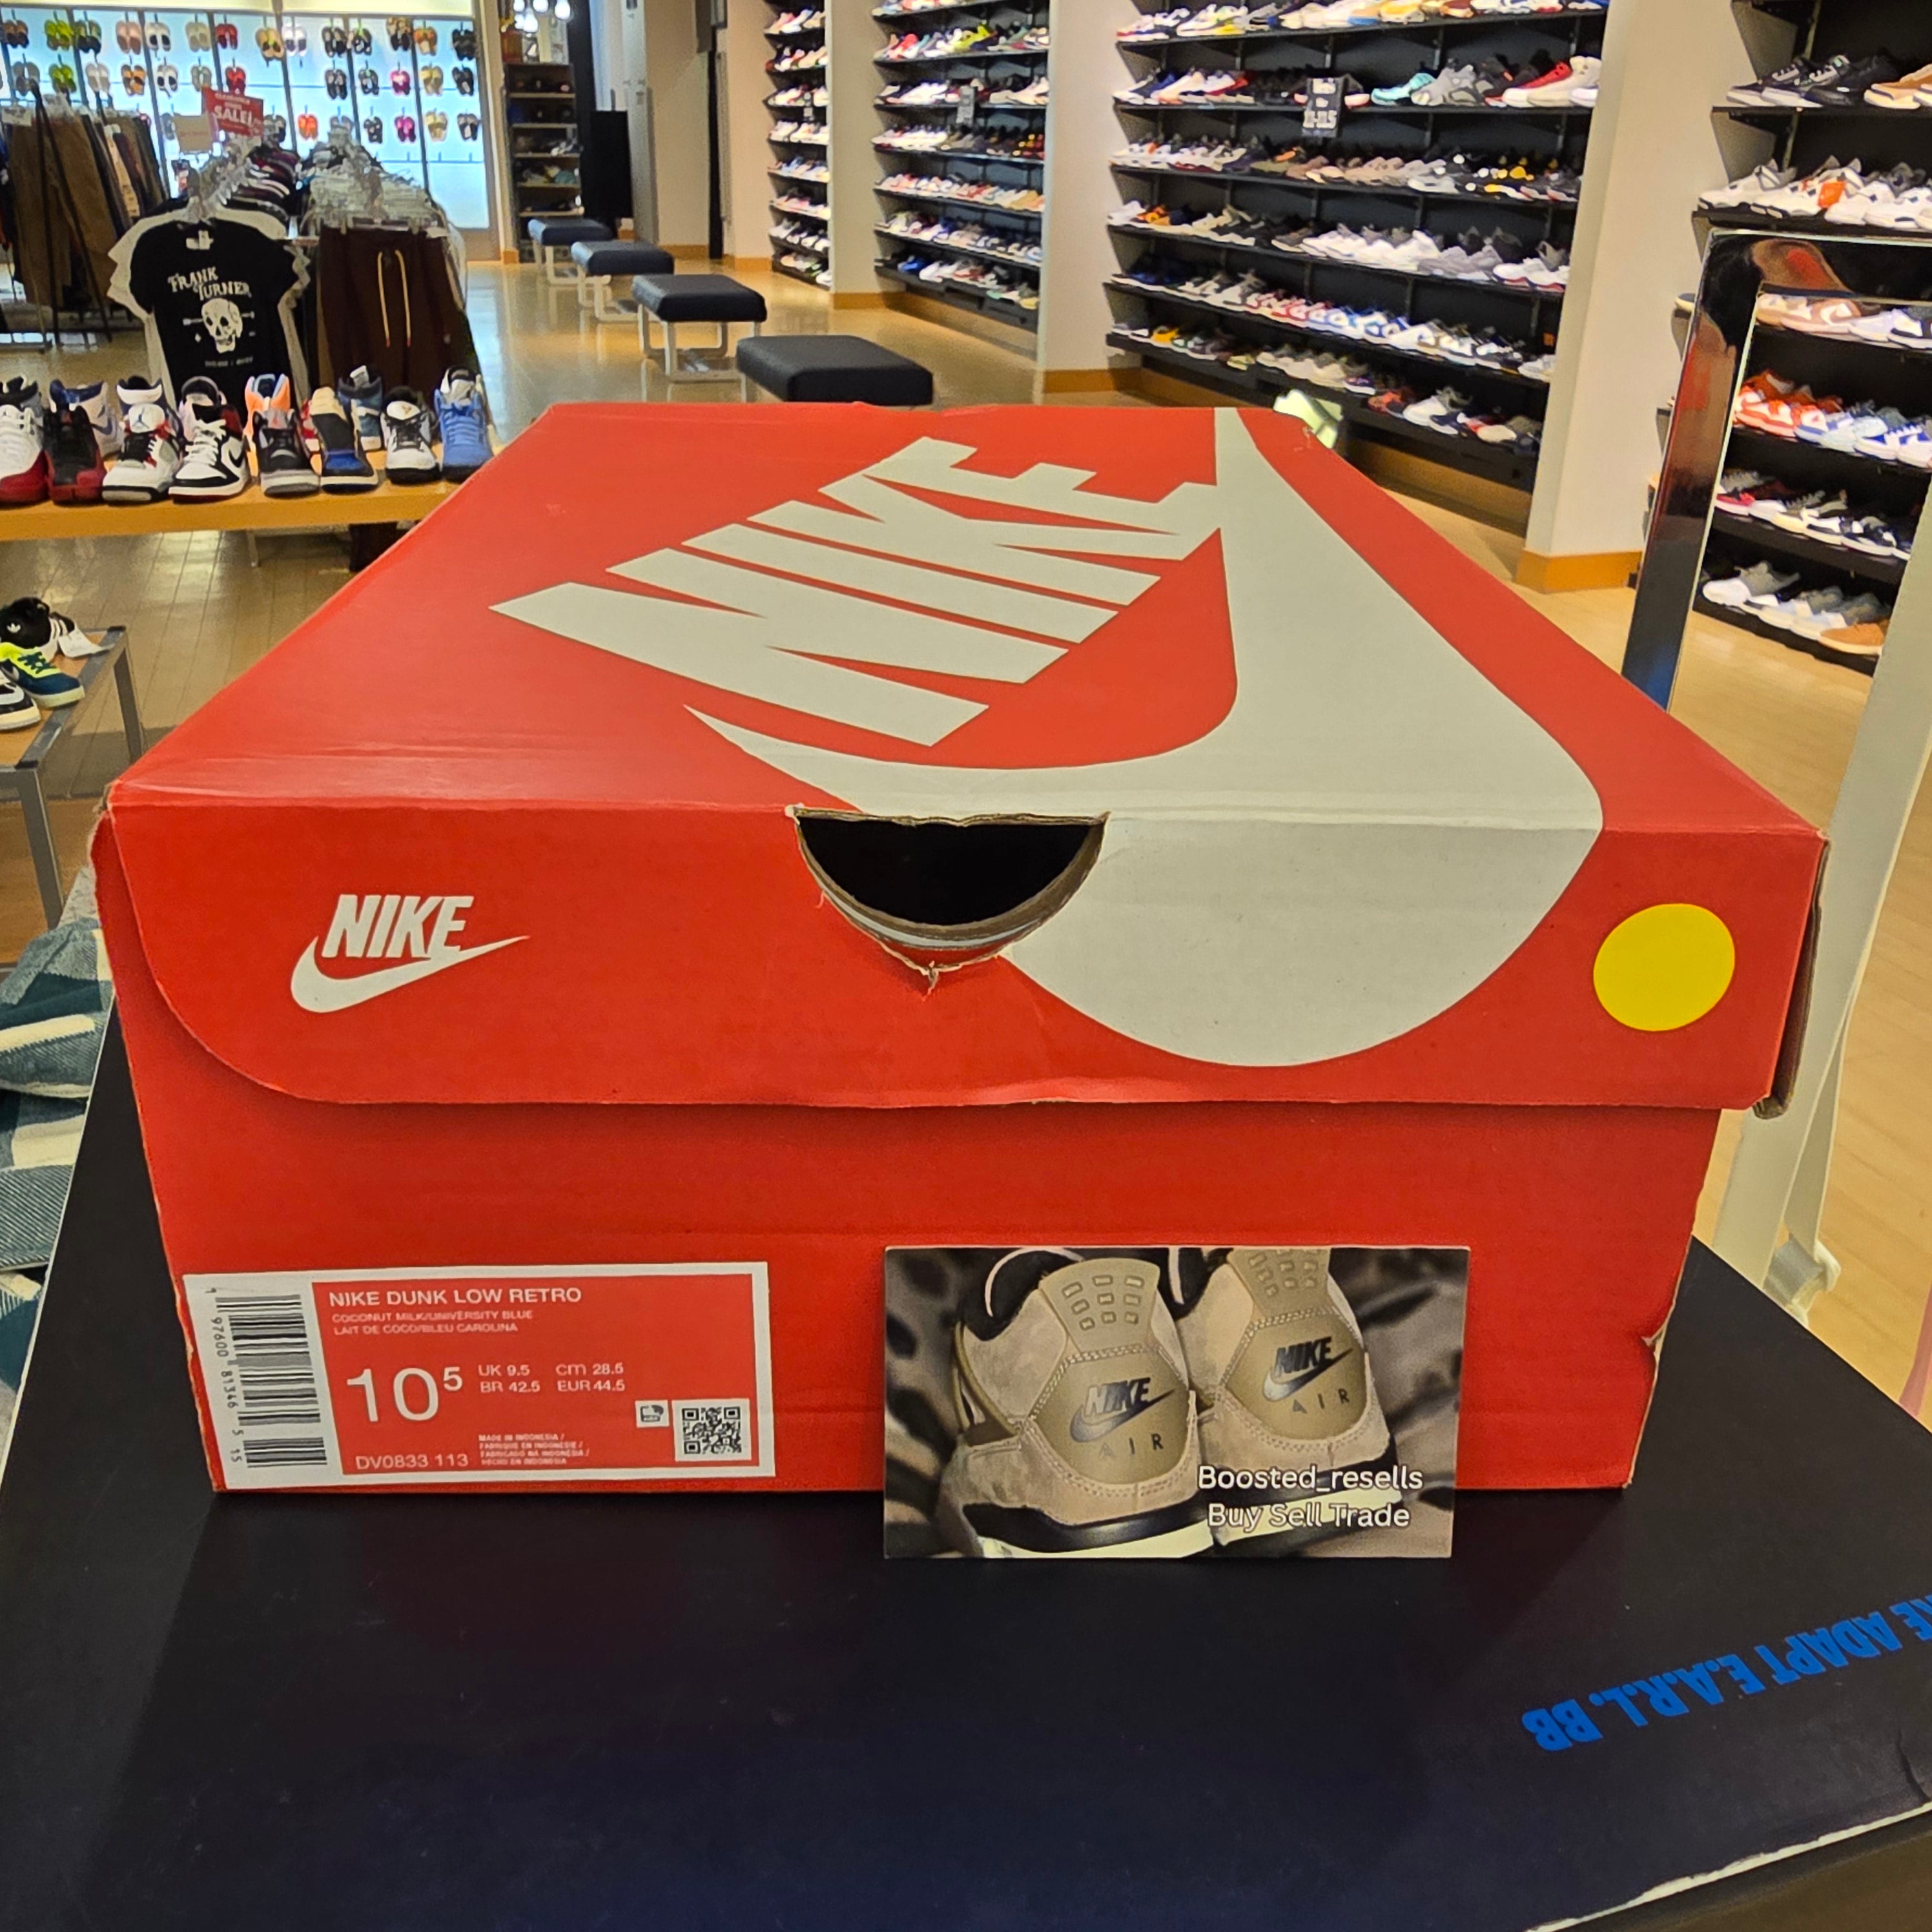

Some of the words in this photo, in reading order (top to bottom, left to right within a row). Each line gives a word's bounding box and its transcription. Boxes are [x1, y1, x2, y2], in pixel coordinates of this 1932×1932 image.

[168, 267, 218, 292] FRANK
[193, 282, 251, 301] TURNER
[489, 437, 1218, 746] NIKE
[321, 894, 474, 960] NIKE
[329, 1291, 380, 1307] NIKE
[387, 1290, 447, 1305] DUNK
[454, 1288, 502, 1304] LOW
[509, 1288, 581, 1303] RETRO
[332, 1313, 392, 1324] COCONUT
[502, 1310, 533, 1320] BLUE
[456, 1322, 518, 1333] CAROLINA
[592, 1363, 624, 1375] 28.5
[1274, 1336, 1332, 1377] NIKE
[478, 1365, 502, 1377] UK
[507, 1364, 530, 1376] 9.5
[480, 1382, 504, 1393] BR
[508, 1381, 540, 1392] 42.5
[557, 1380, 591, 1392] EUR
[593, 1380, 625, 1391] 44.5
[1084, 1377, 1151, 1417] NIKE
[1292, 1388, 1350, 1414] AIR
[1099, 1433, 1164, 1457] AIR
[356, 1454, 429, 1470] DV0833
[435, 1454, 469, 1467] 113
[1198, 1464, 1423, 1492] Boosted_resells
[1208, 1503, 1263, 1532] Buy
[1268, 1502, 1322, 1527] Sell
[1329, 1502, 1410, 1527] Trade
[1754, 1611, 1903, 1685] ADAPT
[1588, 1654, 1766, 1727] E.A.R.L.
[1521, 1699, 1603, 1751] BB
